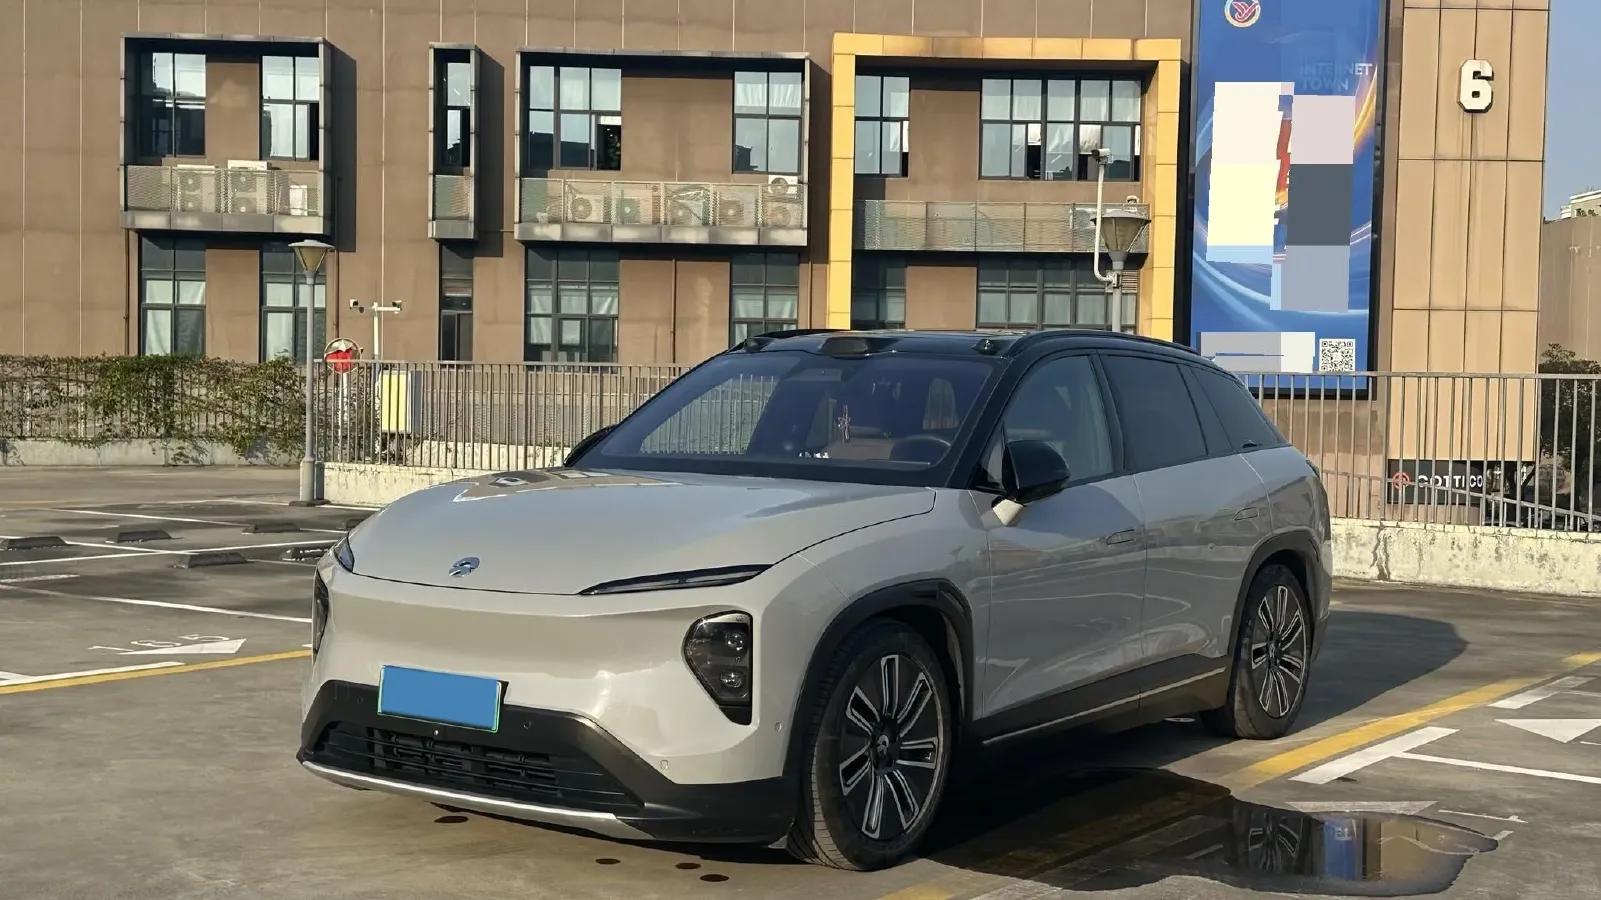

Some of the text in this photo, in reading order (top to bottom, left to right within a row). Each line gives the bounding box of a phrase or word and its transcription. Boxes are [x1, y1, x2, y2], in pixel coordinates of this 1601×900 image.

[1301, 62, 1373, 76] INTERNET
[1302, 77, 1349, 91] TOWN
[1458, 59, 1494, 113] 6
